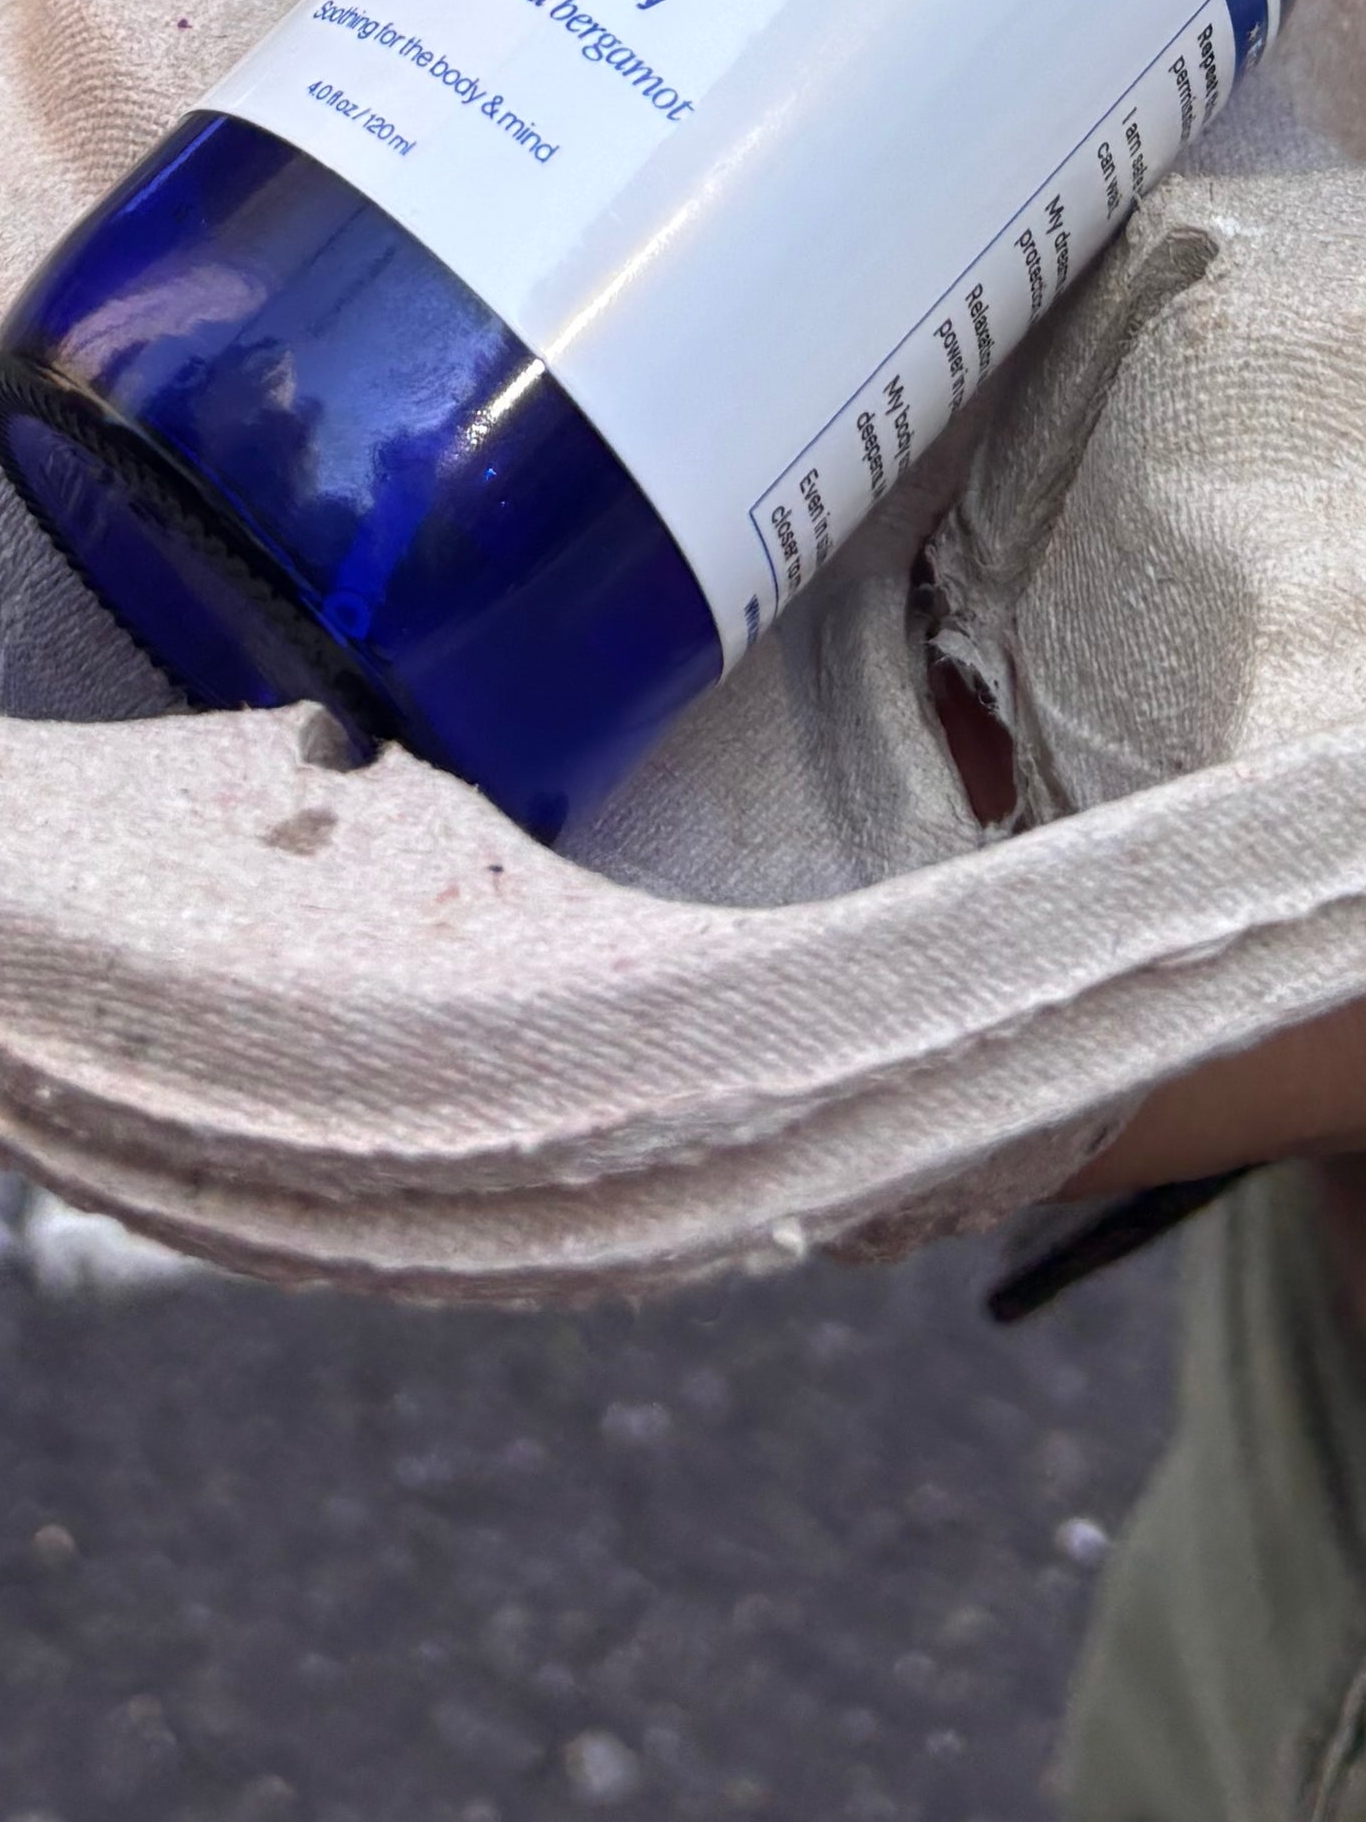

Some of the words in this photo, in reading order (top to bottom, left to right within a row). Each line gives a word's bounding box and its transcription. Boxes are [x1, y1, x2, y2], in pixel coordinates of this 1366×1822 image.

[312, 0, 381, 40] Soothing
[373, 21, 406, 49] for
[398, 36, 435, 68] the
[429, 54, 488, 105] body
[481, 94, 505, 120] &
[496, 108, 561, 164] mind
[1196, 22, 1220, 99] Repeat
[1096, 141, 1117, 182] can
[1124, 122, 1144, 158] am
[1043, 193, 1066, 236] My
[932, 317, 965, 378] power
[882, 373, 905, 416] My
[798, 467, 825, 523] Even
[770, 505, 802, 562] closer
